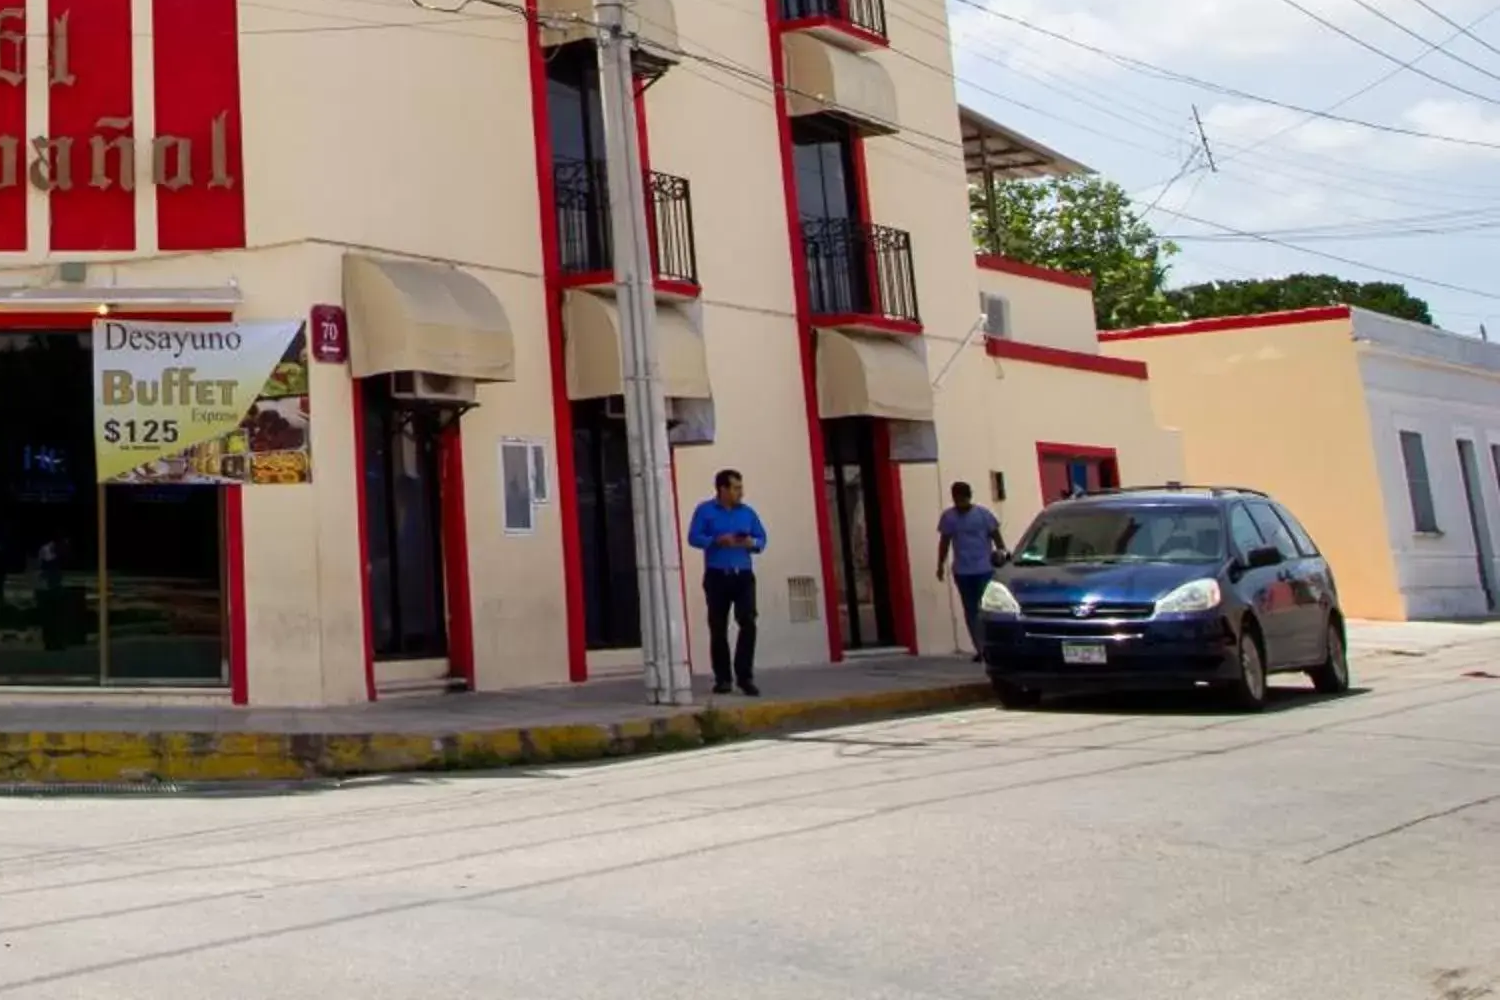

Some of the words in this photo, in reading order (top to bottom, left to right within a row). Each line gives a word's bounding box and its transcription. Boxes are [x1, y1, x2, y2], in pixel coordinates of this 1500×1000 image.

[105, 322, 241, 358] Desayuno
[321, 321, 338, 341] 70
[104, 418, 179, 444] $125
